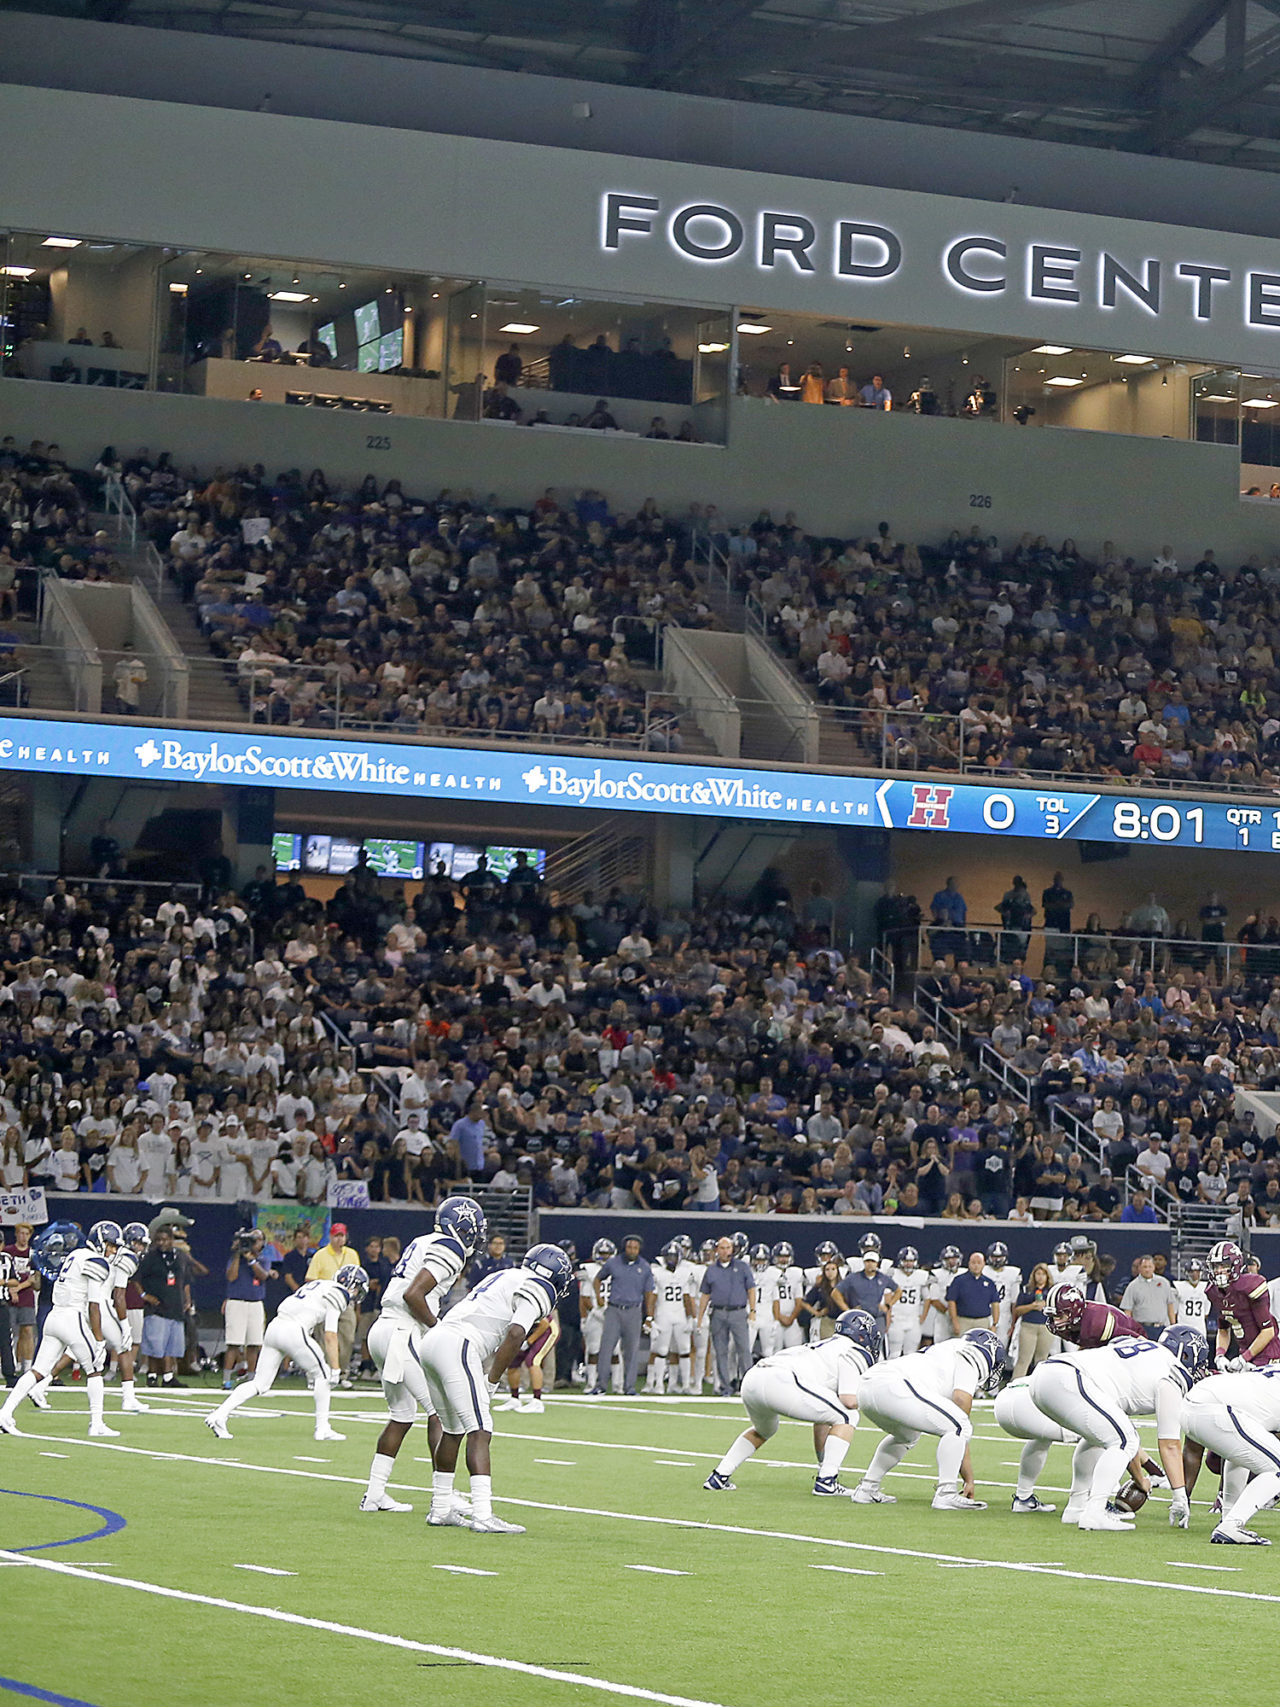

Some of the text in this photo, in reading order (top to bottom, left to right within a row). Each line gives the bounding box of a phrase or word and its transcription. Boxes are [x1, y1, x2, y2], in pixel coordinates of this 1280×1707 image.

[604, 193, 902, 280] FORD
[367, 436, 391, 450] 225
[970, 495, 992, 508] 226
[17, 746, 110, 766] HEALTH
[413, 772, 502, 791] HEALTH
[786, 798, 869, 816] HEALTH
[983, 793, 1015, 830] 0
[1035, 796, 1070, 814] TOL
[1044, 814, 1060, 835] 3
[1112, 801, 1205, 844] 8:01
[1226, 807, 1262, 825] QTR
[1238, 827, 1249, 846] 1
[664, 1286, 683, 1302] 22
[1185, 1300, 1203, 1317] 83
